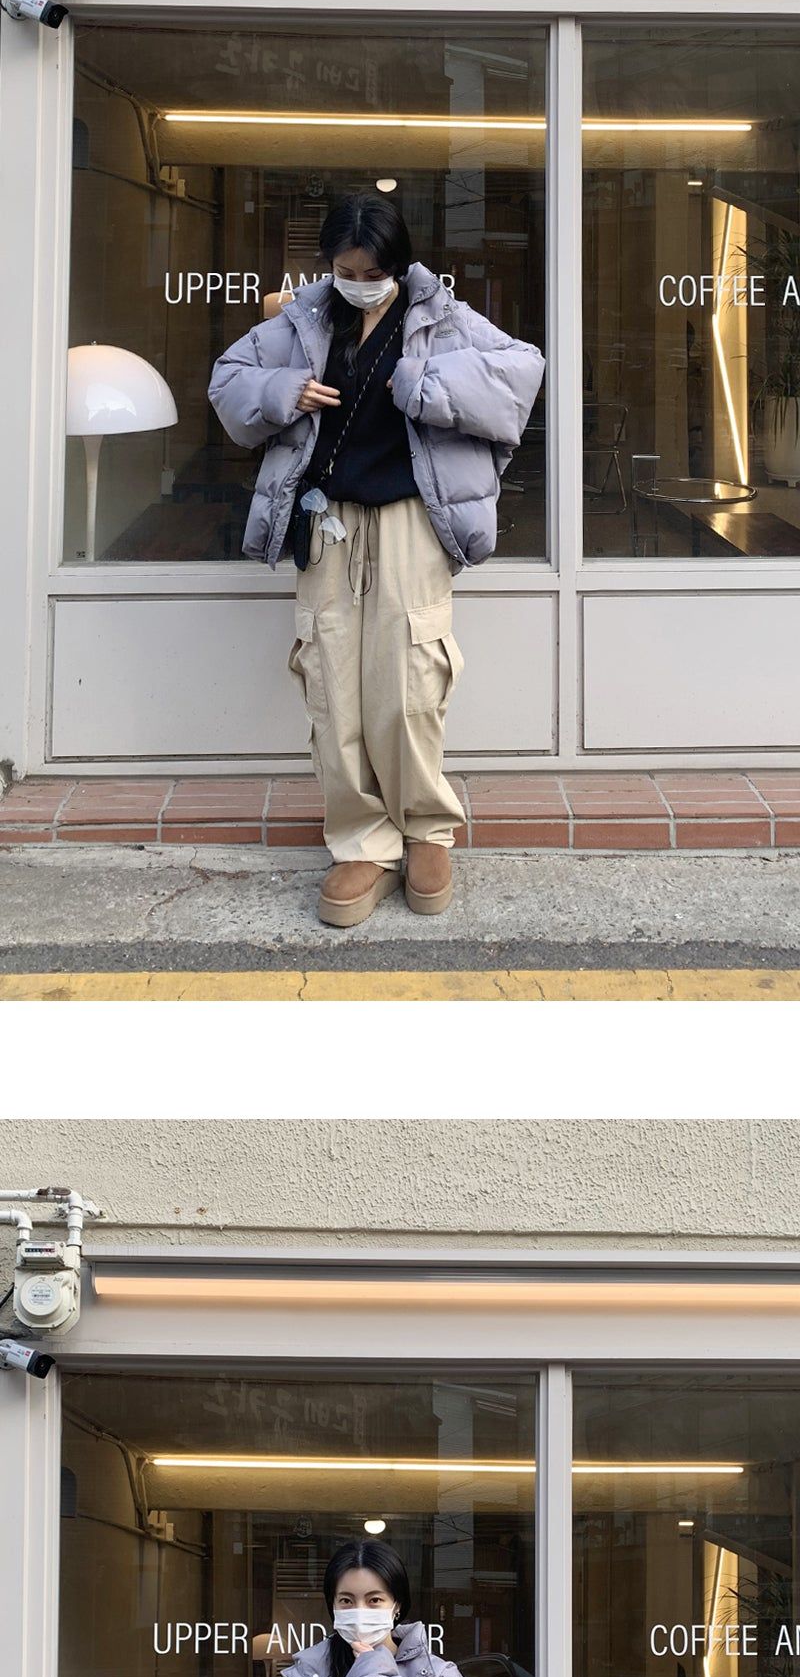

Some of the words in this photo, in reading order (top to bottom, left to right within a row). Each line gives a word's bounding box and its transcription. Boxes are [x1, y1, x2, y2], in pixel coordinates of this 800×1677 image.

[165, 273, 260, 304] UPPER
[659, 274, 766, 307] COFFEE
[153, 1623, 248, 1655] UPPER
[266, 1623, 327, 1654] AND
[650, 1624, 758, 1656] COFFEE
